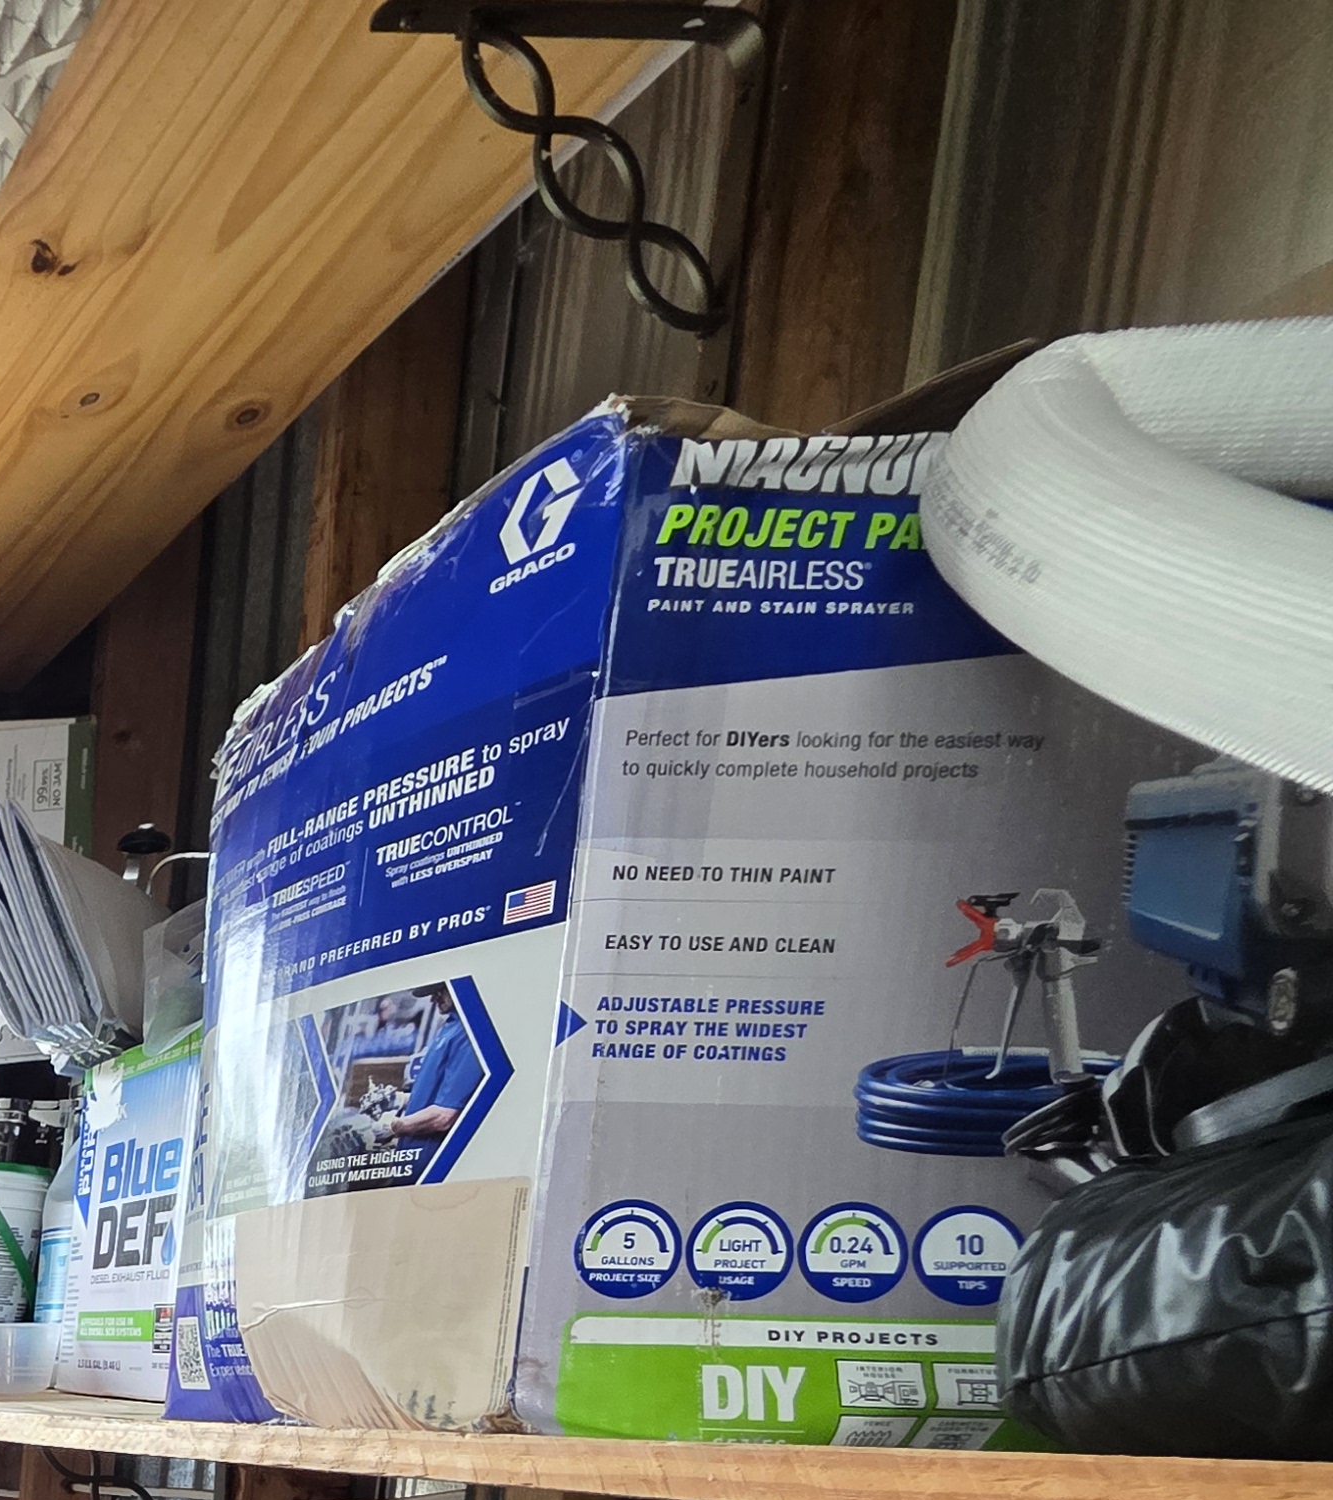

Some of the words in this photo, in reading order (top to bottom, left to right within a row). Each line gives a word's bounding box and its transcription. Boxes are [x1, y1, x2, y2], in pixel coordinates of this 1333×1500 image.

[670, 432, 927, 495] MAGNU
[656, 505, 856, 549] PROJECT
[864, 513, 926, 550] PA
[489, 542, 576, 594] GRACO
[647, 600, 704, 613] PAINT
[712, 602, 751, 614] AND
[760, 602, 817, 614] STAIN
[825, 603, 914, 615] SPRAYER
[625, 729, 690, 748] Perfect
[695, 729, 721, 747] for
[726, 730, 790, 748] DIYers
[796, 731, 861, 752] looking
[867, 731, 894, 748] for
[899, 732, 929, 749] the
[934, 732, 1001, 749] easiest
[1007, 734, 1045, 752] way
[622, 760, 640, 777] to
[646, 760, 710, 780] quickly
[715, 760, 798, 781] complete
[804, 761, 898, 779] household
[902, 762, 979, 783] projects
[267, 795, 359, 859] FULL-RANGE
[362, 746, 476, 812] PRESSURE
[482, 738, 503, 763] to
[508, 717, 572, 755] spray
[289, 844, 304, 866] of
[305, 819, 365, 857] coatings
[368, 765, 496, 830] UNTHINNED
[434, 849, 493, 875] OVERSPRAY
[612, 865, 638, 881] NO
[645, 866, 694, 881] NEED
[699, 866, 724, 882] TO
[730, 867, 773, 883] THIN
[779, 867, 836, 884] PAINT
[319, 928, 403, 967] PREFERRED
[408, 920, 433, 941] BY
[436, 907, 487, 933] PROS
[604, 935, 653, 950] EASY
[658, 935, 683, 951] TO
[688, 936, 725, 952] USE
[729, 936, 768, 953] AND
[774, 937, 836, 954] CLEAN
[597, 997, 719, 1015] ADJUSTABLE
[725, 999, 825, 1016] PRESSURE
[595, 1020, 619, 1035] TO
[624, 1020, 687, 1036] SPRAY
[693, 1021, 729, 1037] THE
[734, 1022, 808, 1038] WIDEST
[592, 1043, 656, 1060] RANGE
[662, 1044, 687, 1060] OF
[692, 1045, 787, 1062] COATINGS
[316, 1156, 345, 1171] USING
[347, 1154, 369, 1168] THE
[370, 1148, 423, 1165] HIGHEST
[103, 1138, 184, 1202] Blue
[308, 1172, 346, 1187] QUALITY
[348, 1165, 413, 1184] MATERIALS
[92, 1193, 177, 1270] DEF
[623, 1233, 635, 1249] 5
[719, 1238, 762, 1254] LIGHT
[829, 1237, 873, 1255] 0.24
[955, 1235, 984, 1255] 10
[600, 1256, 655, 1267] GALLONS
[713, 1258, 766, 1270] PROJECT
[840, 1259, 867, 1269] GPM
[933, 1261, 1007, 1272] SUPPORTED
[111, 1270, 145, 1284] EXHAUST
[146, 1269, 170, 1281] FLUID
[589, 1272, 635, 1284] PROJECT
[637, 1273, 661, 1284] SIZE
[718, 1275, 755, 1286] USAGE
[832, 1277, 871, 1289] SPEED
[957, 1279, 987, 1290] TIPS
[767, 1330, 806, 1343] DIY
[816, 1331, 939, 1346] PROJECTS
[700, 1364, 806, 1422] DIY
